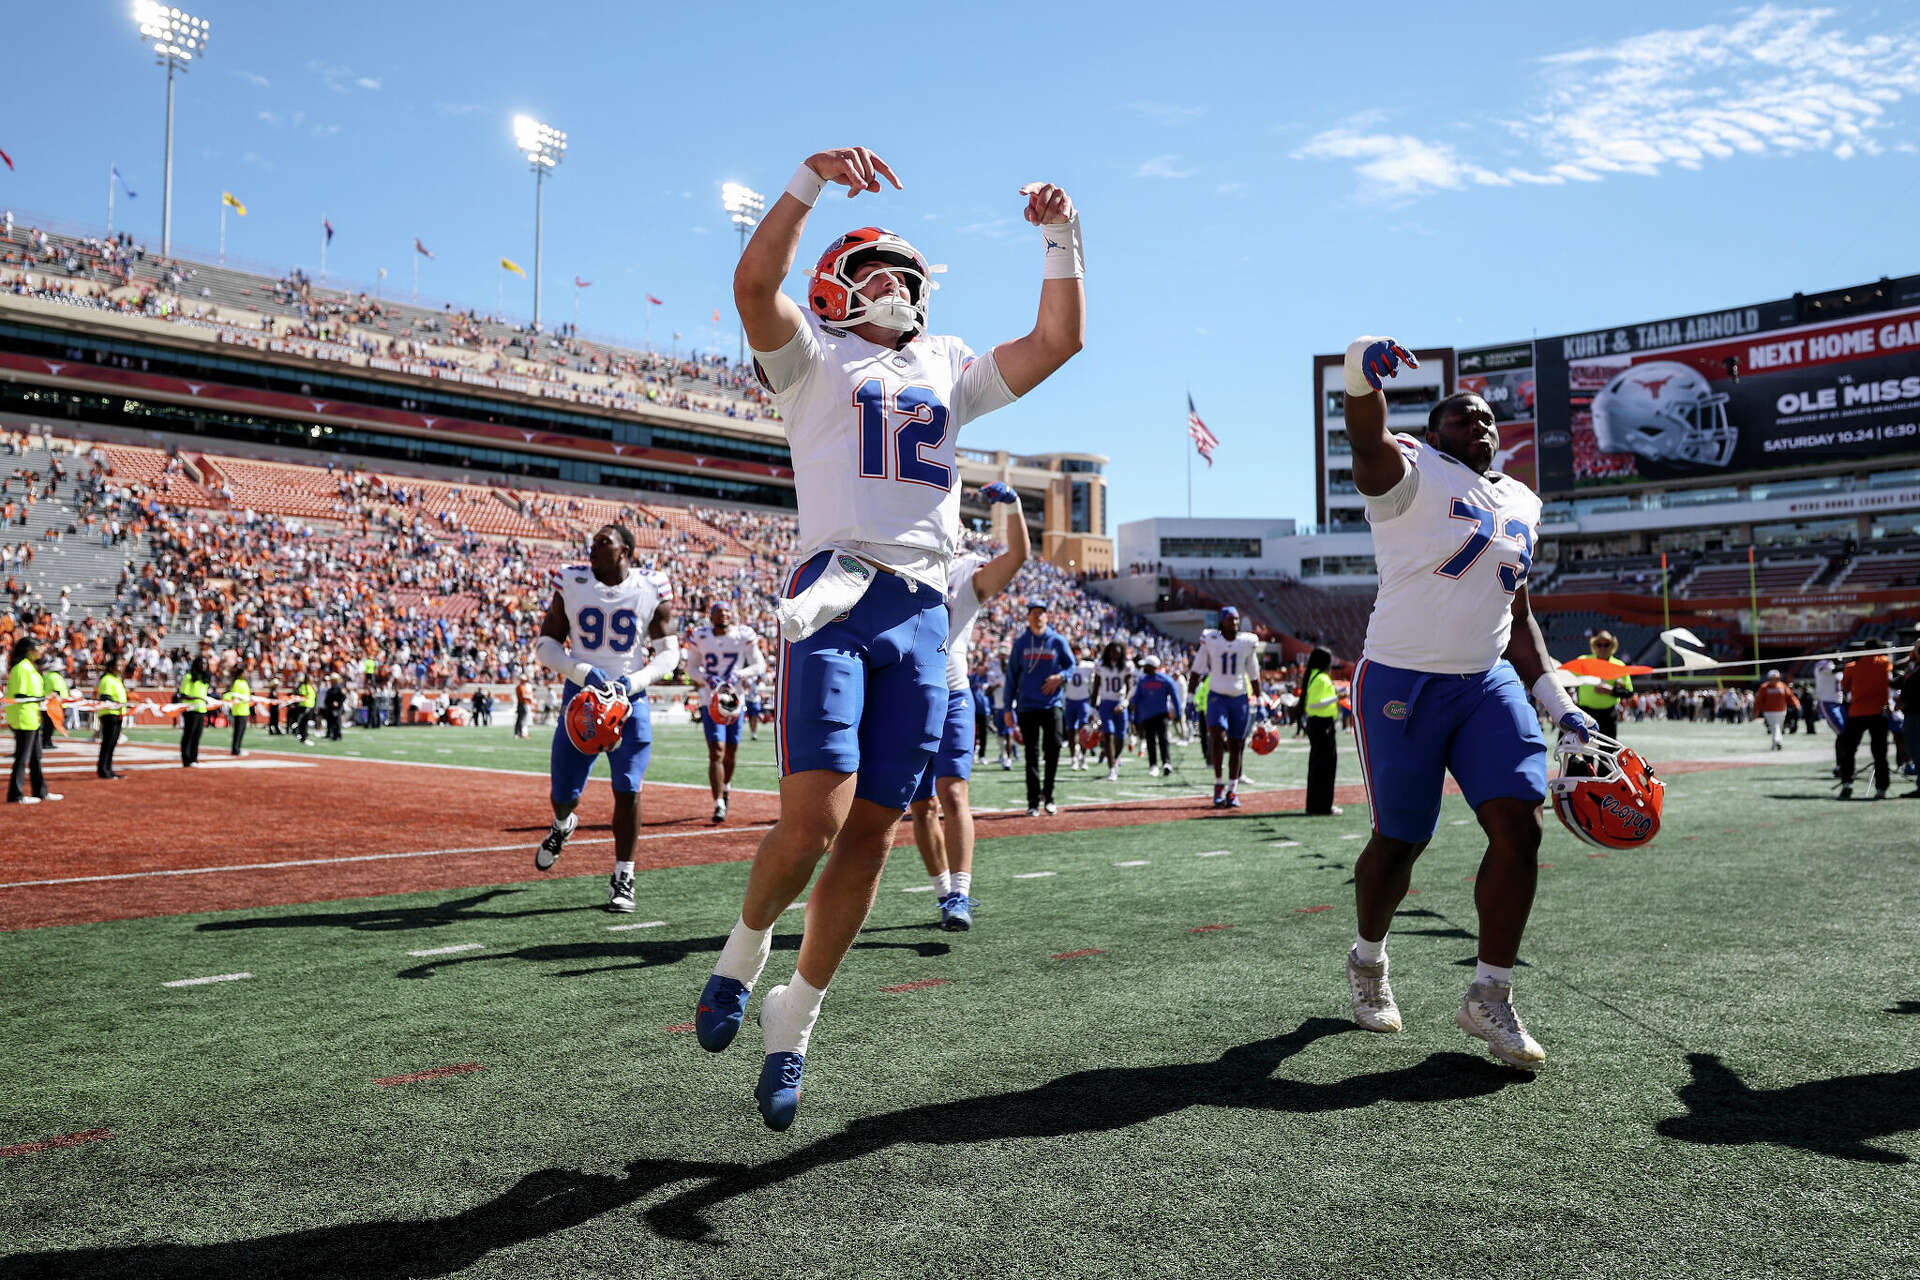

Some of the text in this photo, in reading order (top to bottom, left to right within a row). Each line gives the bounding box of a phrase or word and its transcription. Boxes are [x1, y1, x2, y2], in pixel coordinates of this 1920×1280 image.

[1563, 333, 1609, 360] KURT
[1613, 330, 1632, 351] &
[1636, 320, 1681, 350] TARA
[1685, 308, 1760, 340] ARNOLD
[1749, 339, 1805, 370] NEXT
[1808, 328, 1875, 361] HOME
[1776, 375, 1920, 415] OLE MISS
[852, 376, 951, 493] 12
[1763, 433, 1835, 452] SATURDAY
[1837, 428, 1874, 444] 10.24
[1884, 423, 1917, 438] 6:30
[1433, 497, 1535, 594] 73
[577, 604, 638, 654] 99
[705, 652, 739, 678] 27
[1105, 676, 1121, 693] 10
[1221, 652, 1238, 675] 11
[1601, 794, 1652, 837] Gators
